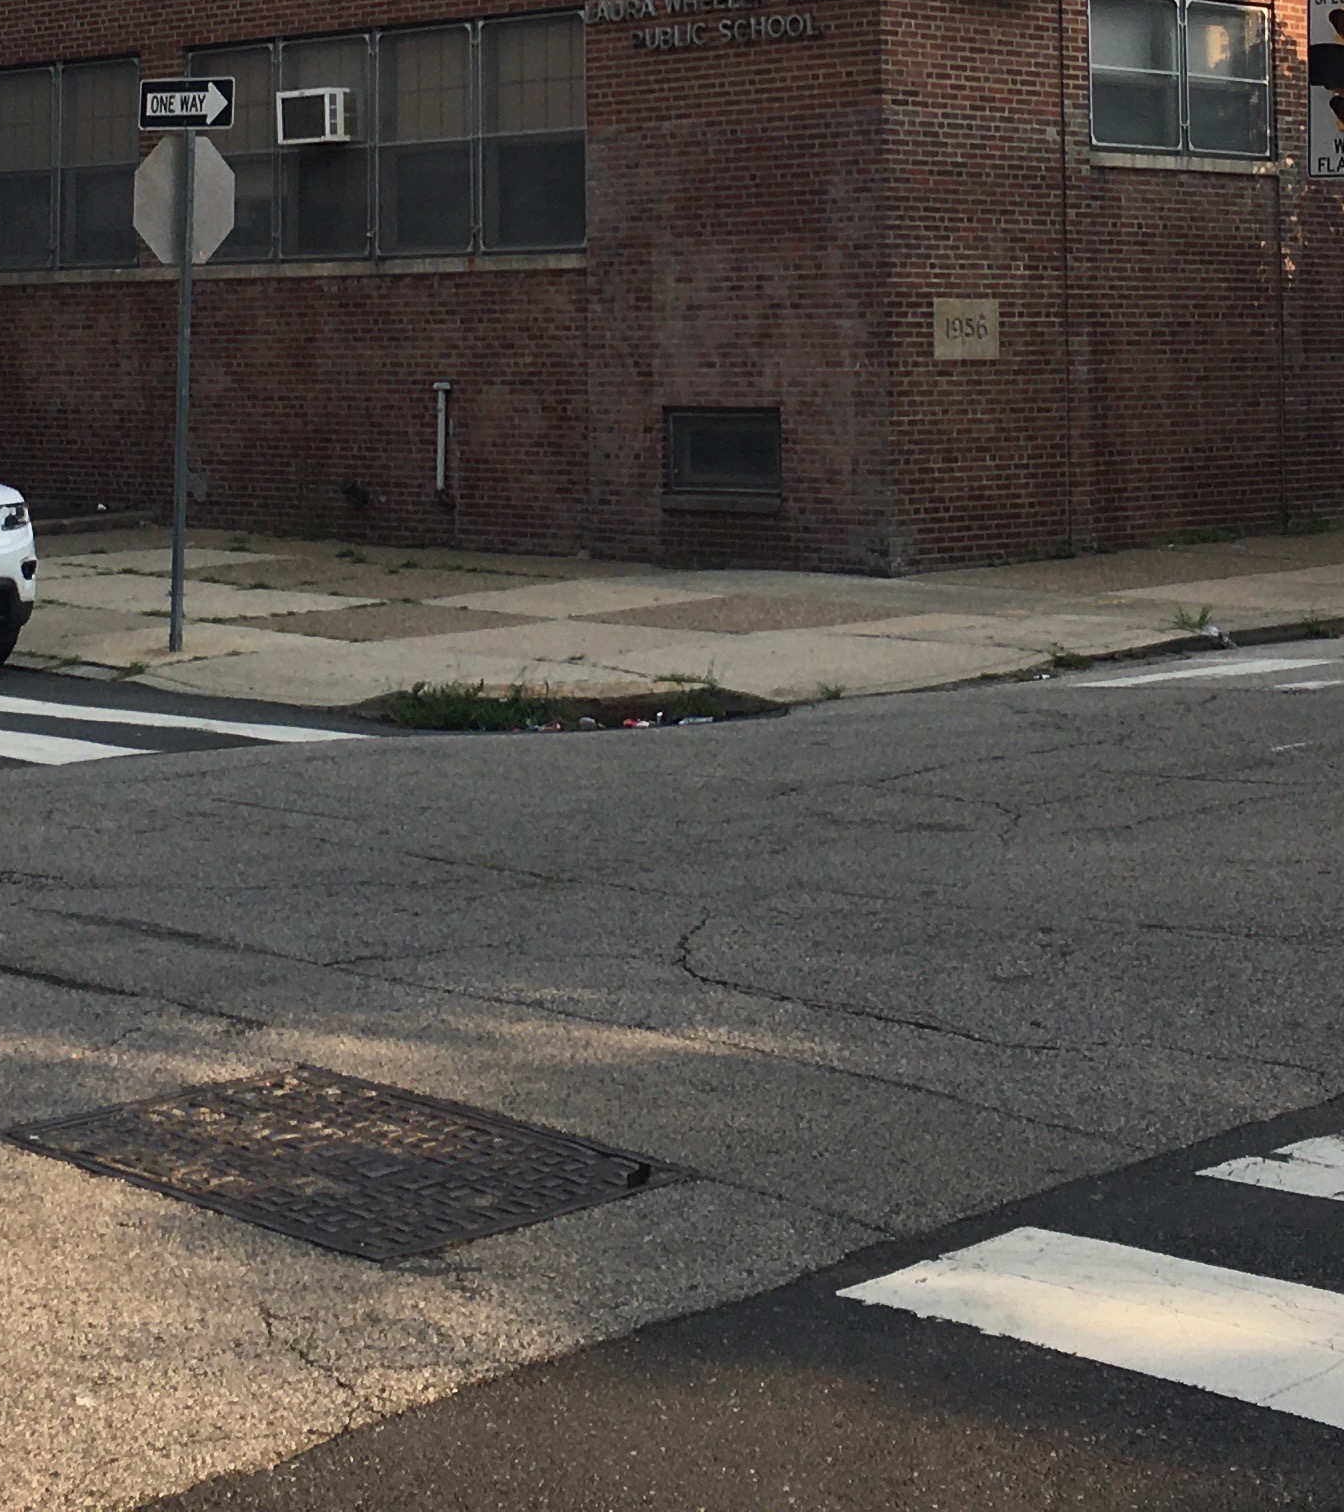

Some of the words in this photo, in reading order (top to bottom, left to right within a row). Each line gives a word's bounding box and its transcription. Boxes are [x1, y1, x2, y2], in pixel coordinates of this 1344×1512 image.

[631, 23, 708, 50] PUBLIC
[718, 14, 815, 42] SCHOOL
[150, 94, 175, 114] ONE
[179, 94, 206, 113] WAY
[944, 316, 989, 340] 1956
